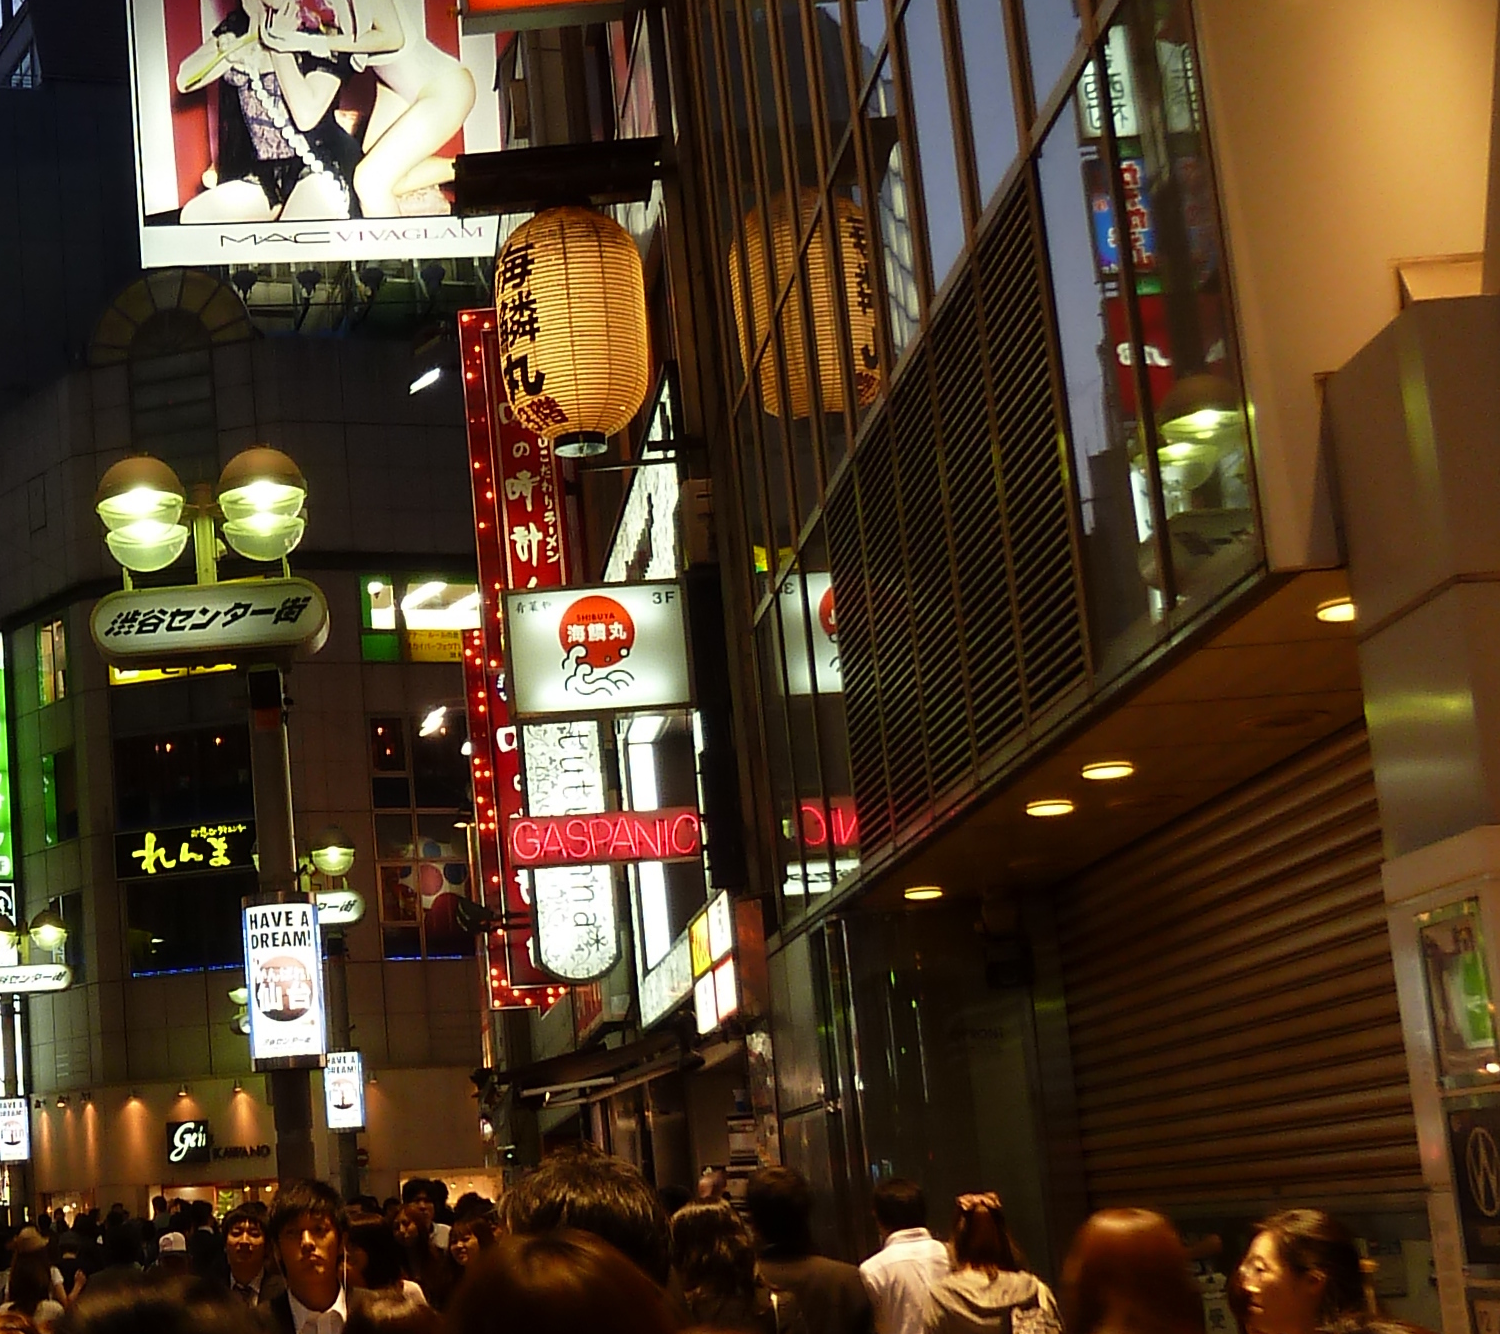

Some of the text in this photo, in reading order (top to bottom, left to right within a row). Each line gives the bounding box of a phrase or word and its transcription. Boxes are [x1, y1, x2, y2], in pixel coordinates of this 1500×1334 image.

[652, 591, 675, 605] 3F
[104, 595, 312, 638] 渋谷センター街
[576, 612, 615, 621] SHIBUYA
[512, 813, 699, 860] GASPANIC
[249, 910, 309, 930] HAVE A
[251, 929, 312, 950] DREAM!
